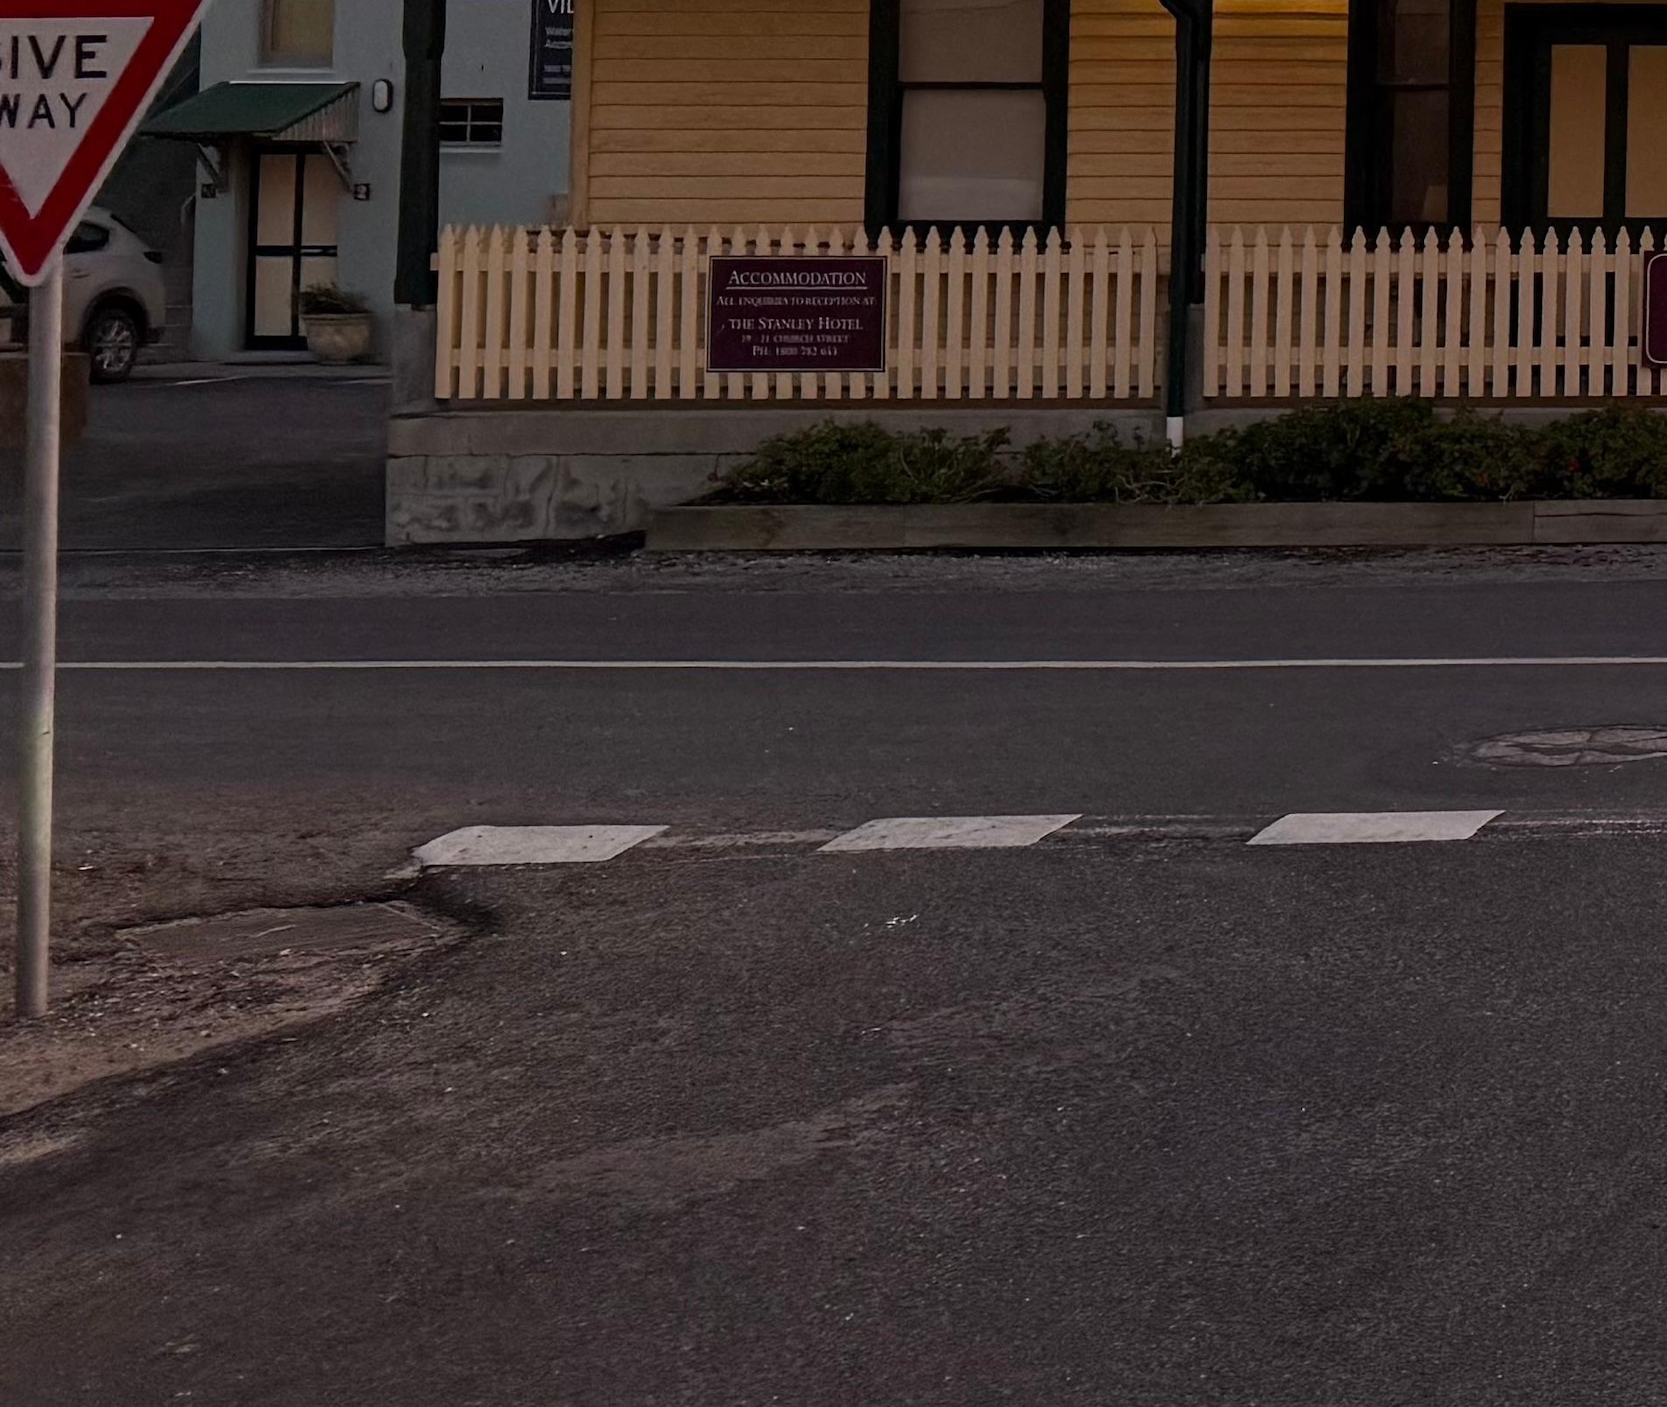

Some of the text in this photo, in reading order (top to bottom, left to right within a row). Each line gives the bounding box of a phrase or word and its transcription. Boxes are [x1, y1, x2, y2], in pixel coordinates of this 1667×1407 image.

[0, 34, 107, 80] IVE
[729, 270, 866, 285] ACCOMMODATION
[728, 317, 863, 331] THE STANLEY HOTEL
